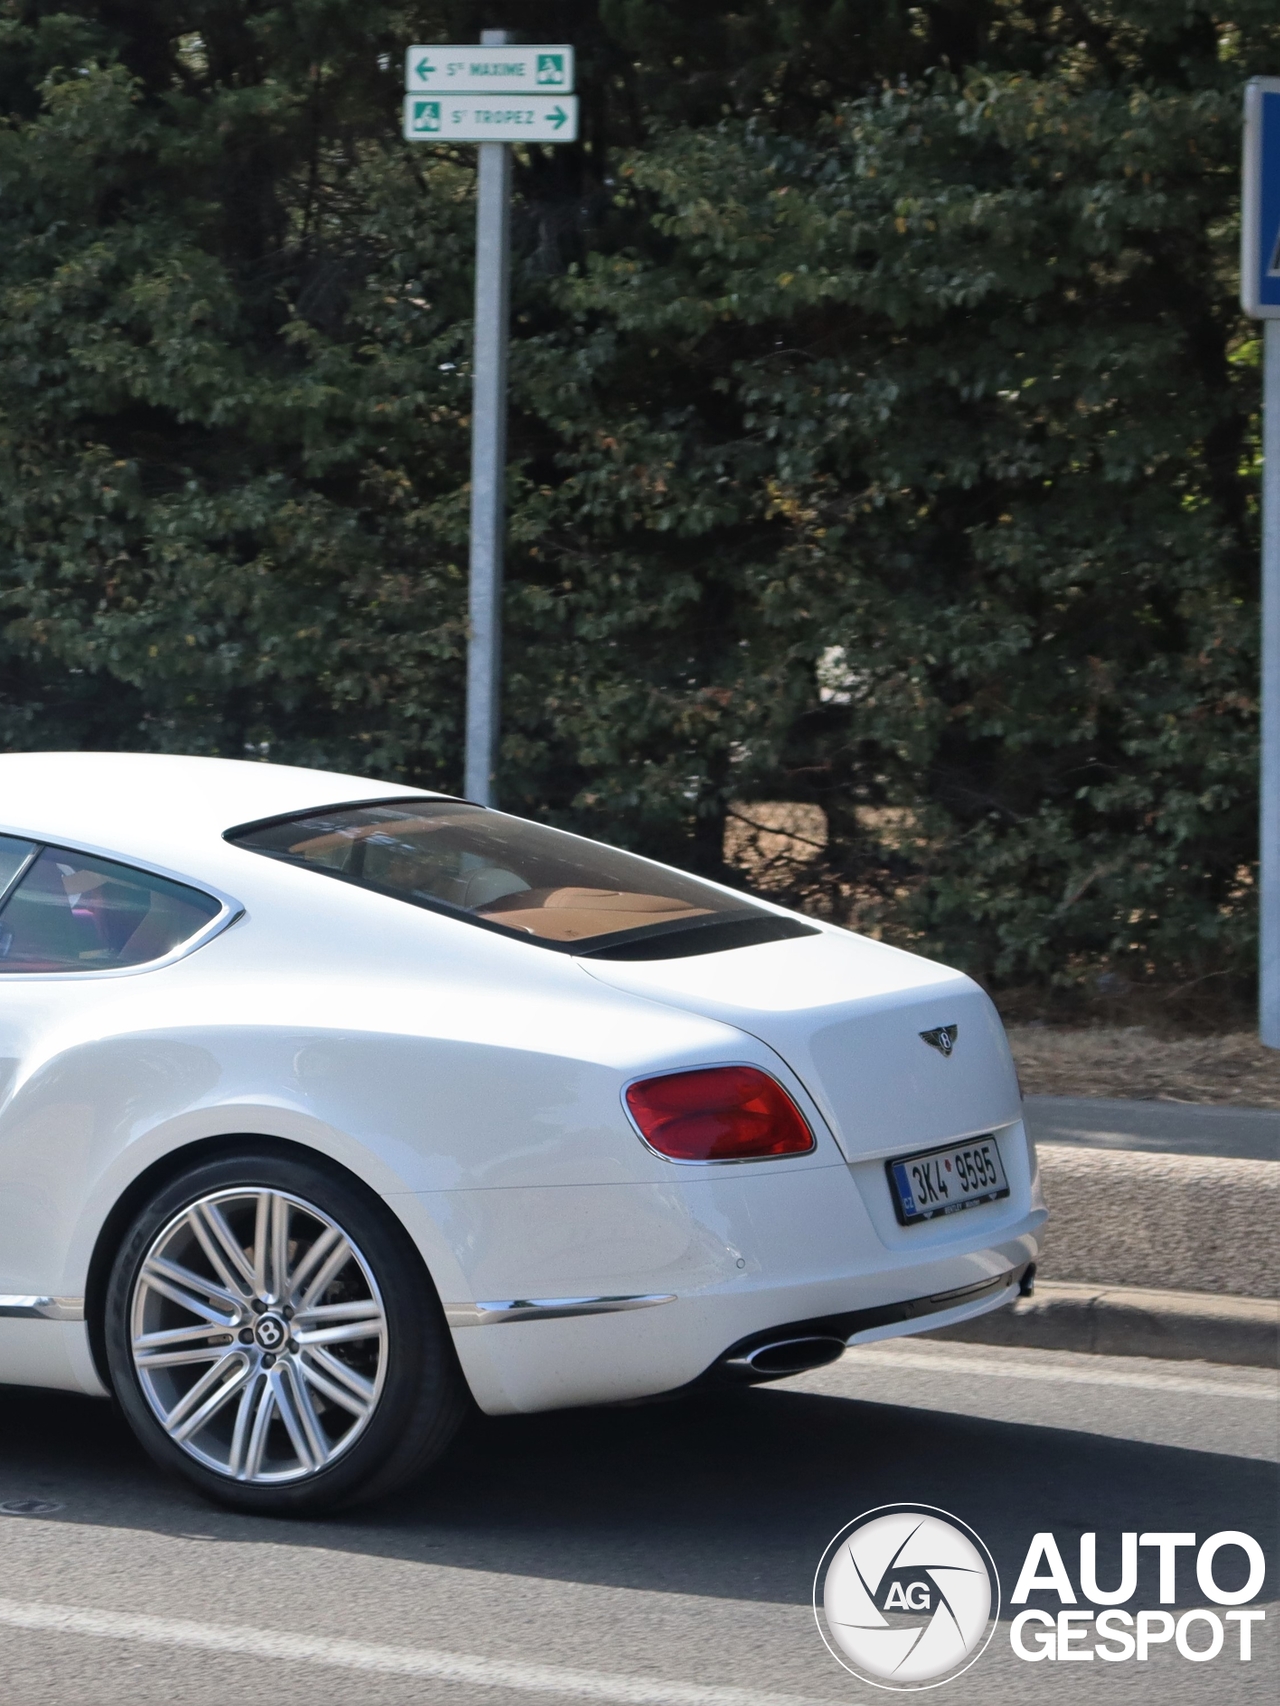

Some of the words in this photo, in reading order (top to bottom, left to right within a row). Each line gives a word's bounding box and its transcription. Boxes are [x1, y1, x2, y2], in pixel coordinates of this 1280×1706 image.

[470, 63, 526, 76] MAXIME
[475, 110, 535, 124] TROPEZ
[912, 1160, 949, 1205] 3K4
[955, 1146, 997, 1192] 9595
[903, 1197, 915, 1210] CZ
[257, 1321, 280, 1345] B
